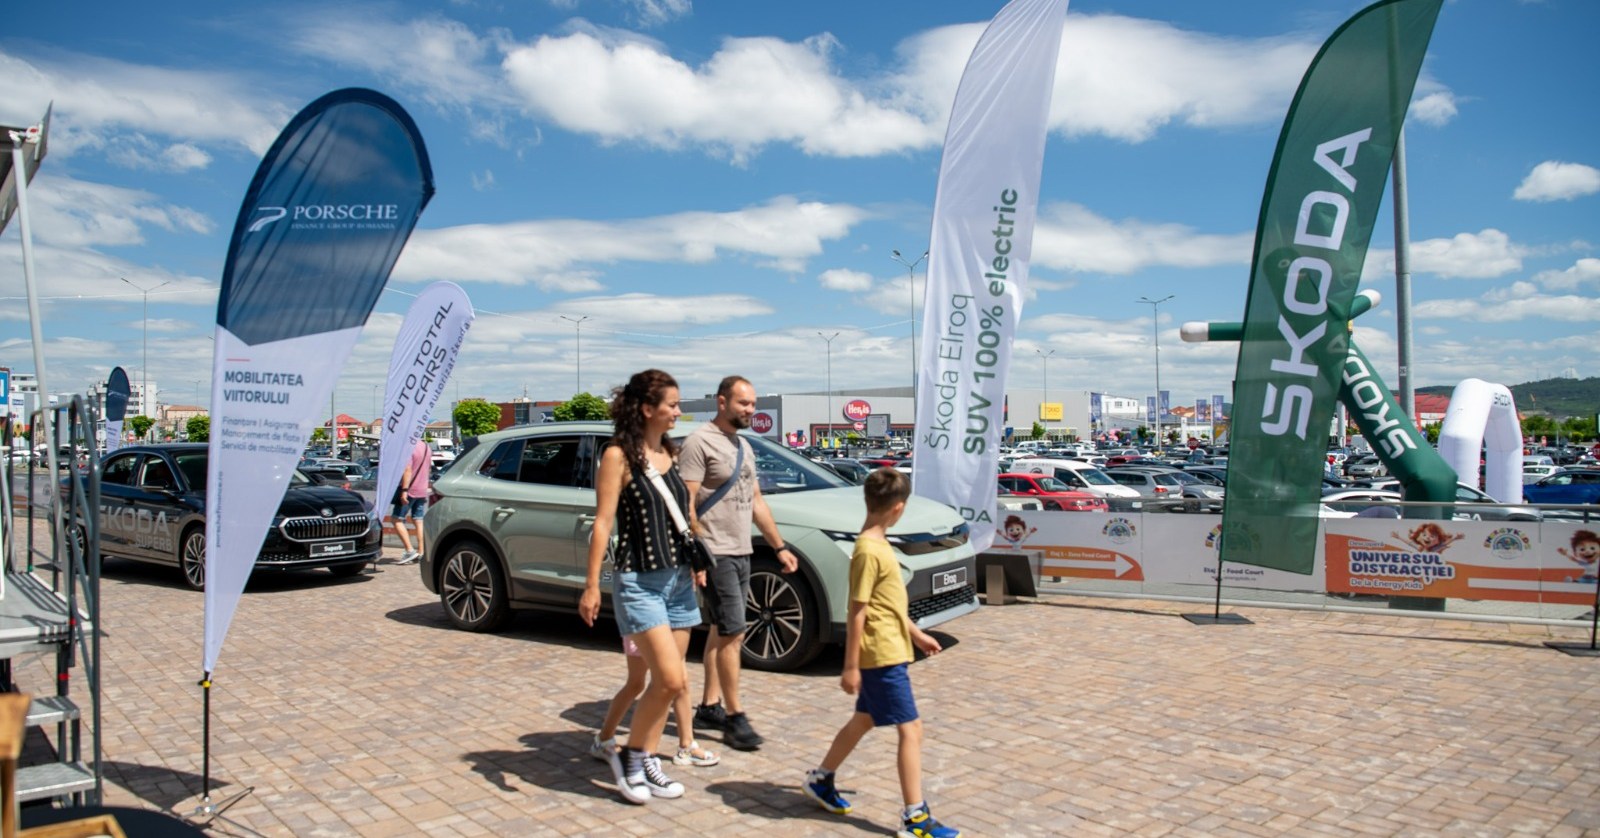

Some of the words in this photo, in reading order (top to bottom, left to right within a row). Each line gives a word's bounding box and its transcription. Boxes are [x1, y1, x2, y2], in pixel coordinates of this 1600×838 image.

[293, 204, 398, 220] PORSCHE
[984, 188, 1018, 297] electric
[939, 293, 975, 361] Elroq
[973, 305, 1003, 383] 100%
[387, 373, 416, 433] AUTO
[414, 301, 453, 370] TOTAL
[224, 371, 304, 386] MOBILITATEA
[414, 347, 447, 405] CARS
[223, 389, 290, 404] VIITORULUI
[409, 411, 431, 446] dealer
[429, 356, 456, 408] autorizat
[924, 370, 959, 450] Škoda
[263, 419, 299, 430] Asigurare
[963, 391, 992, 455] SUV
[221, 429, 270, 441] Management
[271, 431, 281, 440] de
[221, 440, 247, 450] Servicii
[248, 442, 257, 451] de
[135, 534, 172, 552] SUPERB
[323, 544, 343, 552] Superb
[1351, 551, 1443, 565] UNIVERSUL
[1350, 578, 1362, 586] De
[1373, 579, 1403, 589] Energy
[1404, 580, 1422, 589] Kids
